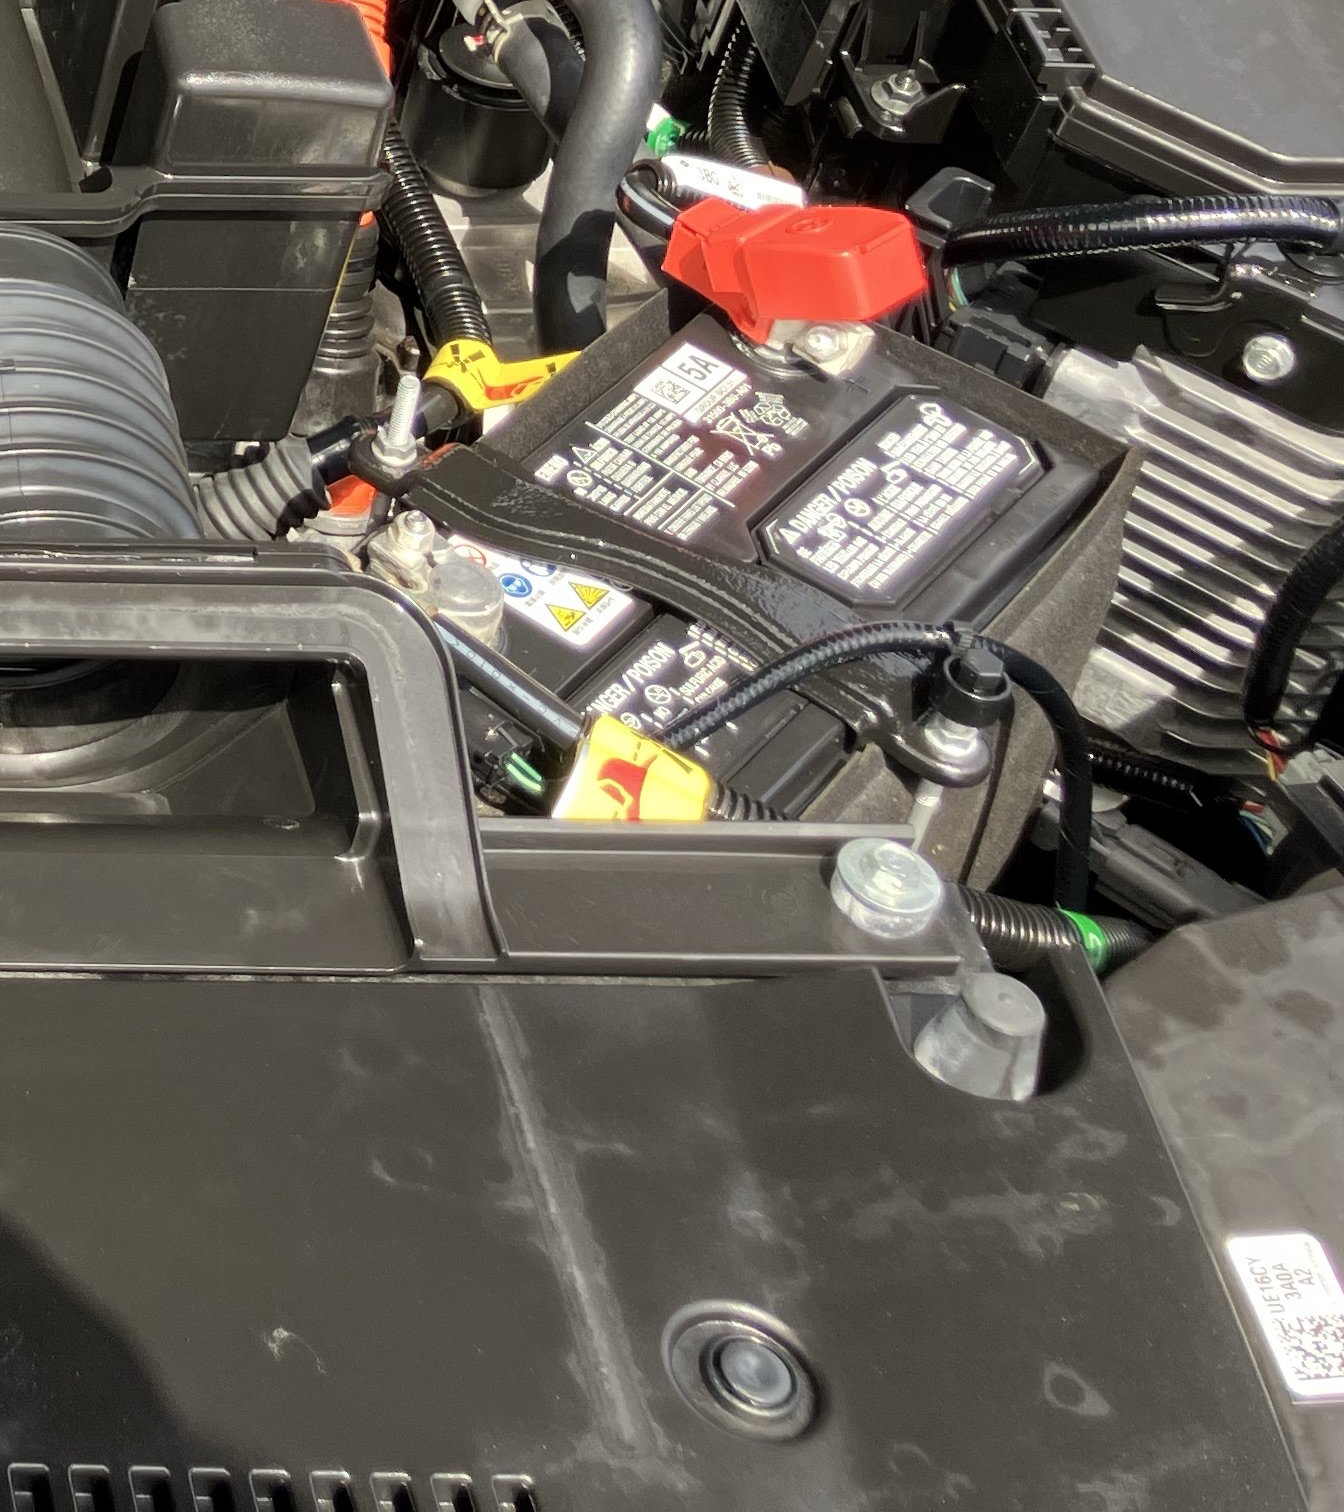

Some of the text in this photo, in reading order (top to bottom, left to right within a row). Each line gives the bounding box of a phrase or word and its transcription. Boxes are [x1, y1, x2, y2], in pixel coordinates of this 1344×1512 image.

[677, 354, 720, 382] 5A
[1246, 1256, 1285, 1314] UE16CY
[1272, 1262, 1302, 1300] 3A0A
[1294, 1268, 1316, 1286] A2
